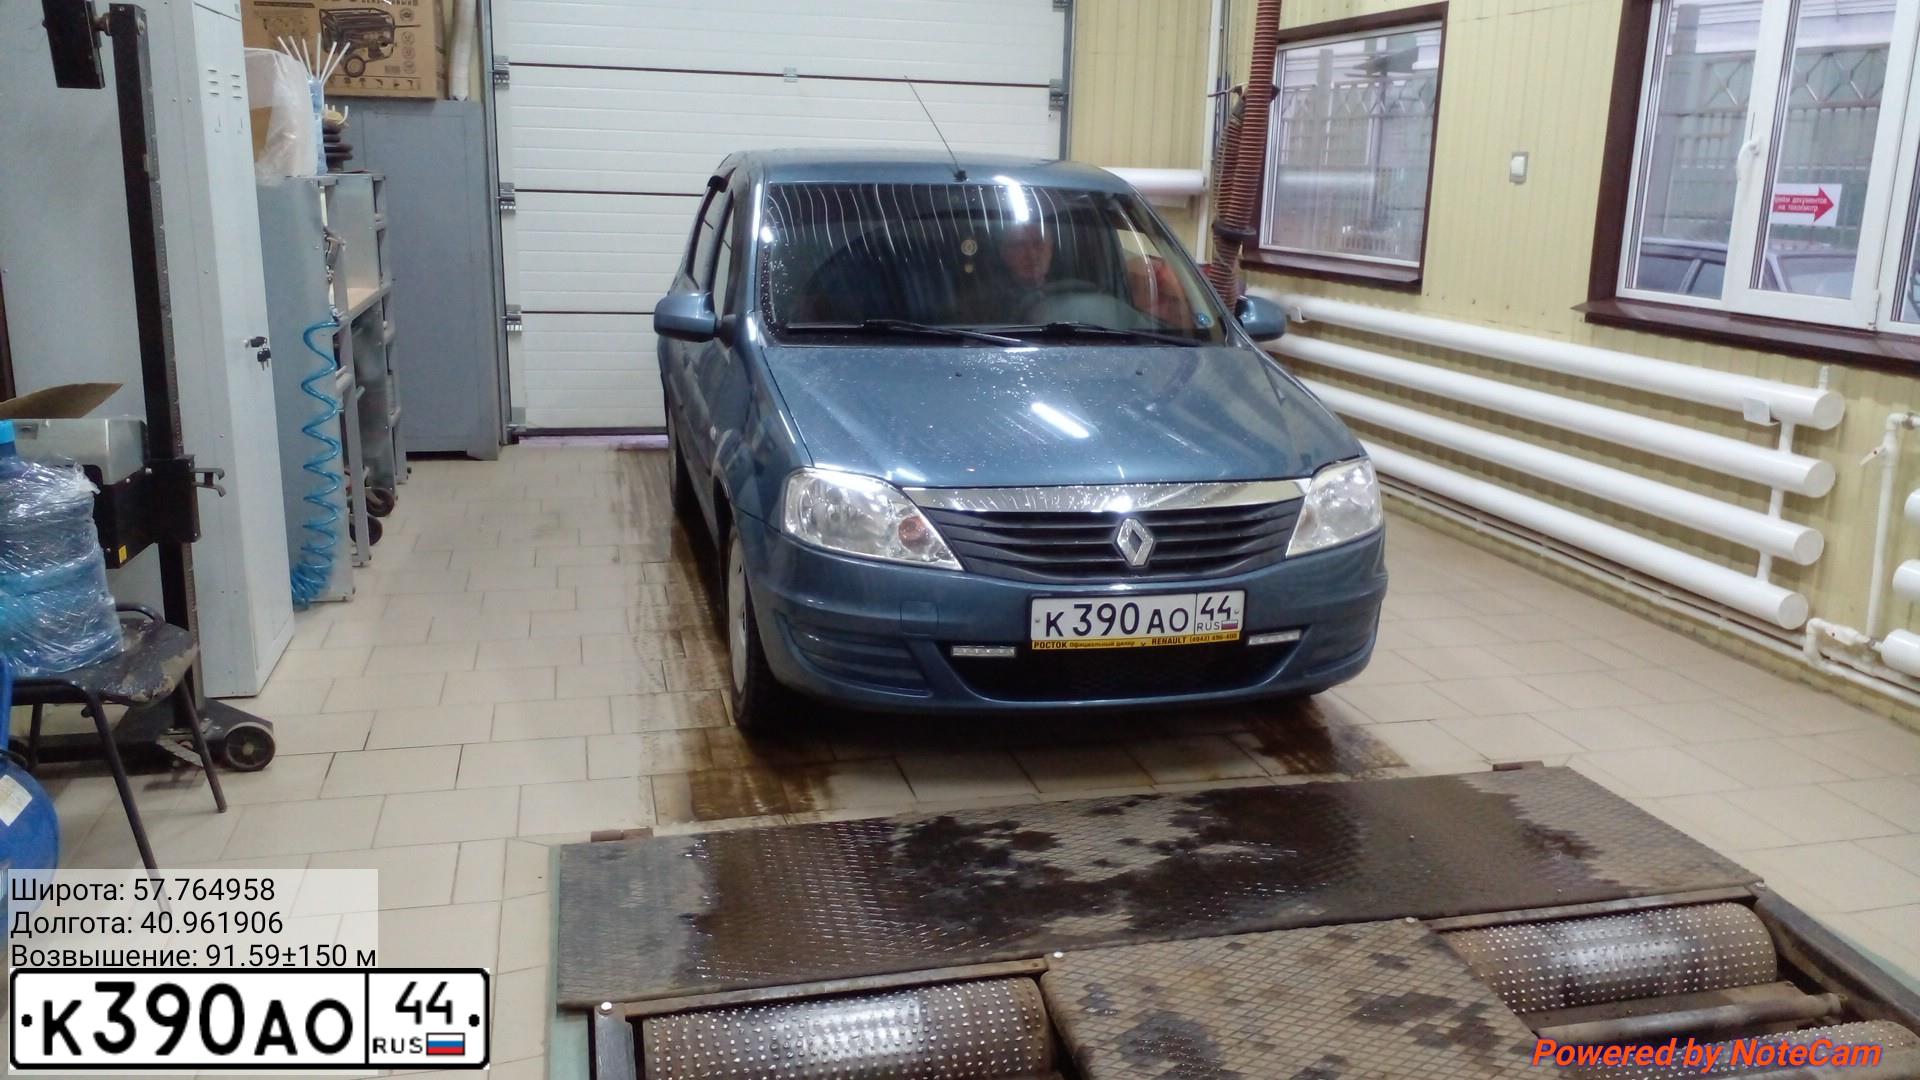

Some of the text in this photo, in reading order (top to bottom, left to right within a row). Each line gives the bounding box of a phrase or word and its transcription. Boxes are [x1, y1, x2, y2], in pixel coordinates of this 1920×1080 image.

[1200, 595, 1232, 621] 44
[1196, 620, 1220, 632] RUS
[1033, 641, 1067, 649] РОСТОК
[1151, 637, 1186, 645] RENAULT
